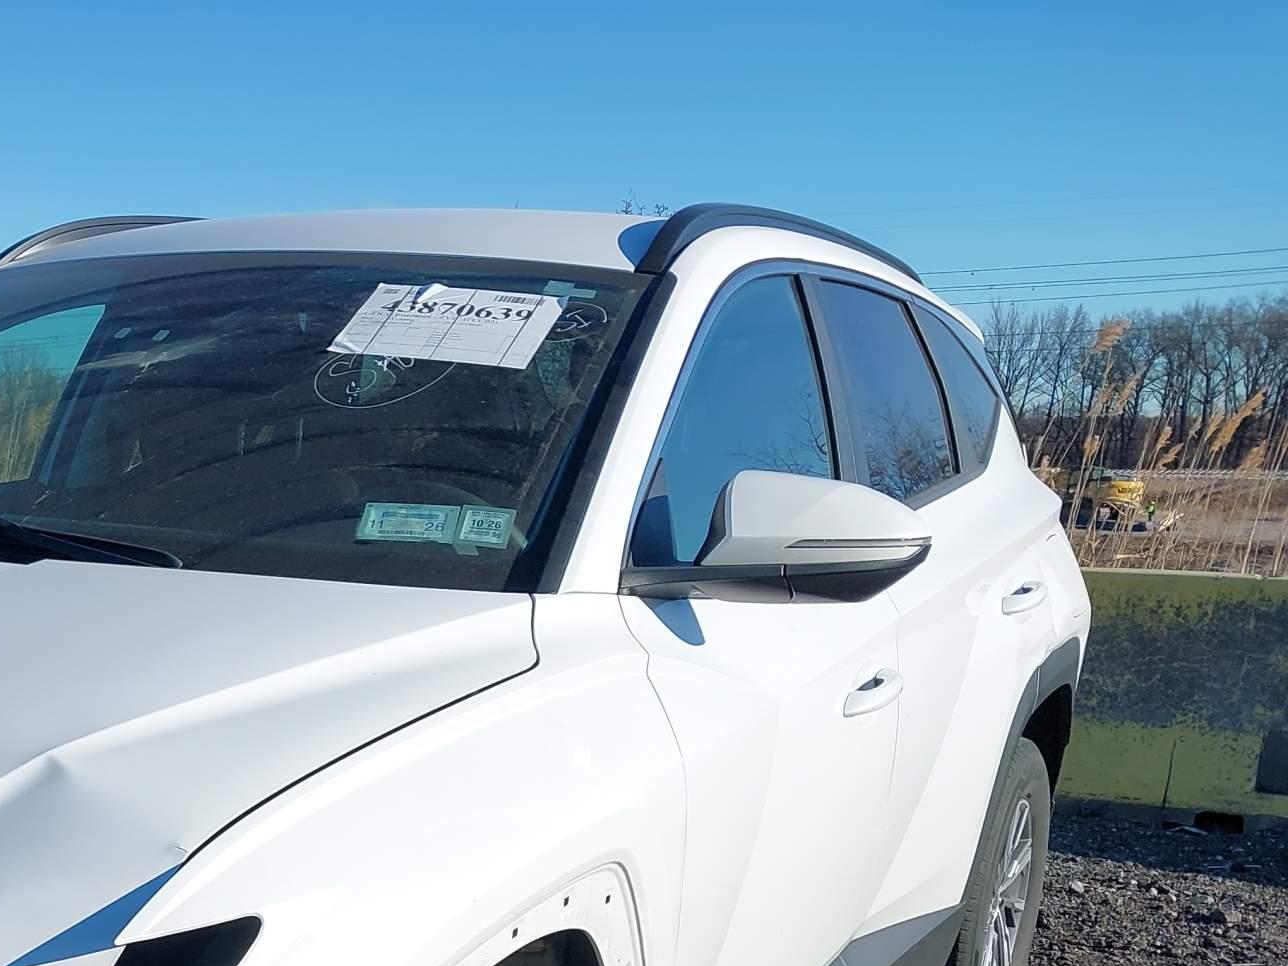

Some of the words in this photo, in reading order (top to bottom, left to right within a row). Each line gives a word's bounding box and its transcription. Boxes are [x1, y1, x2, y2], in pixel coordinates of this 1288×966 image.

[381, 299, 533, 323] 43870639
[424, 521, 445, 532] 26
[471, 519, 484, 527] 10
[487, 520, 502, 529] 26
